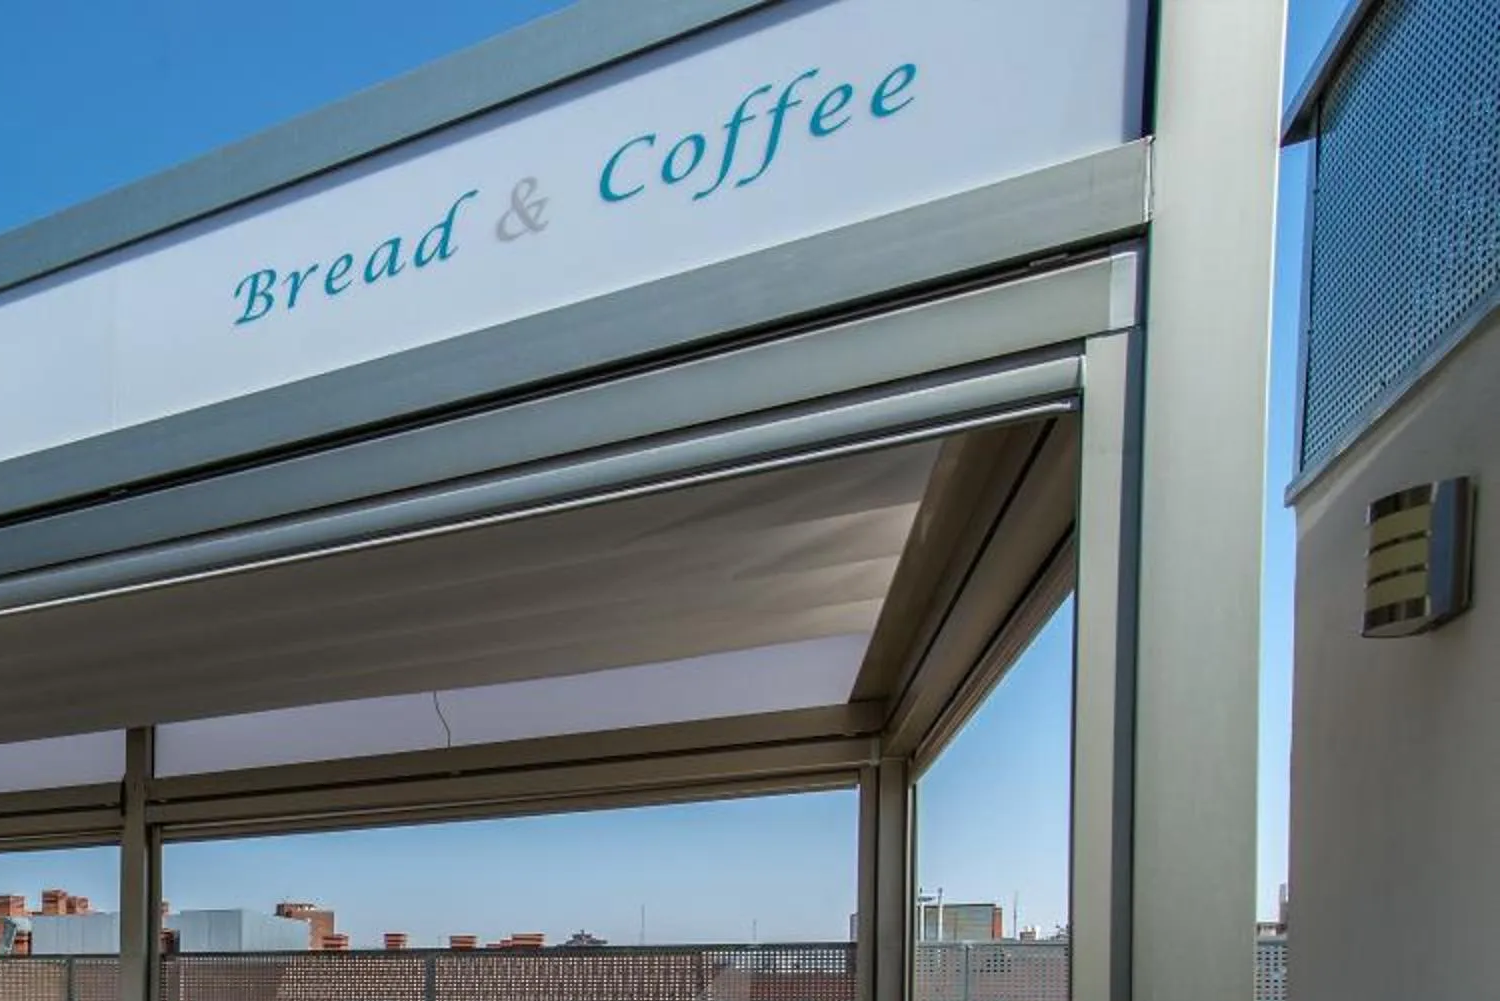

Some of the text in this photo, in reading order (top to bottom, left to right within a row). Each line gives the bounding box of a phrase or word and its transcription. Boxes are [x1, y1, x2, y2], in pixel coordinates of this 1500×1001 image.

[233, 62, 918, 325] Bread & Coffee
